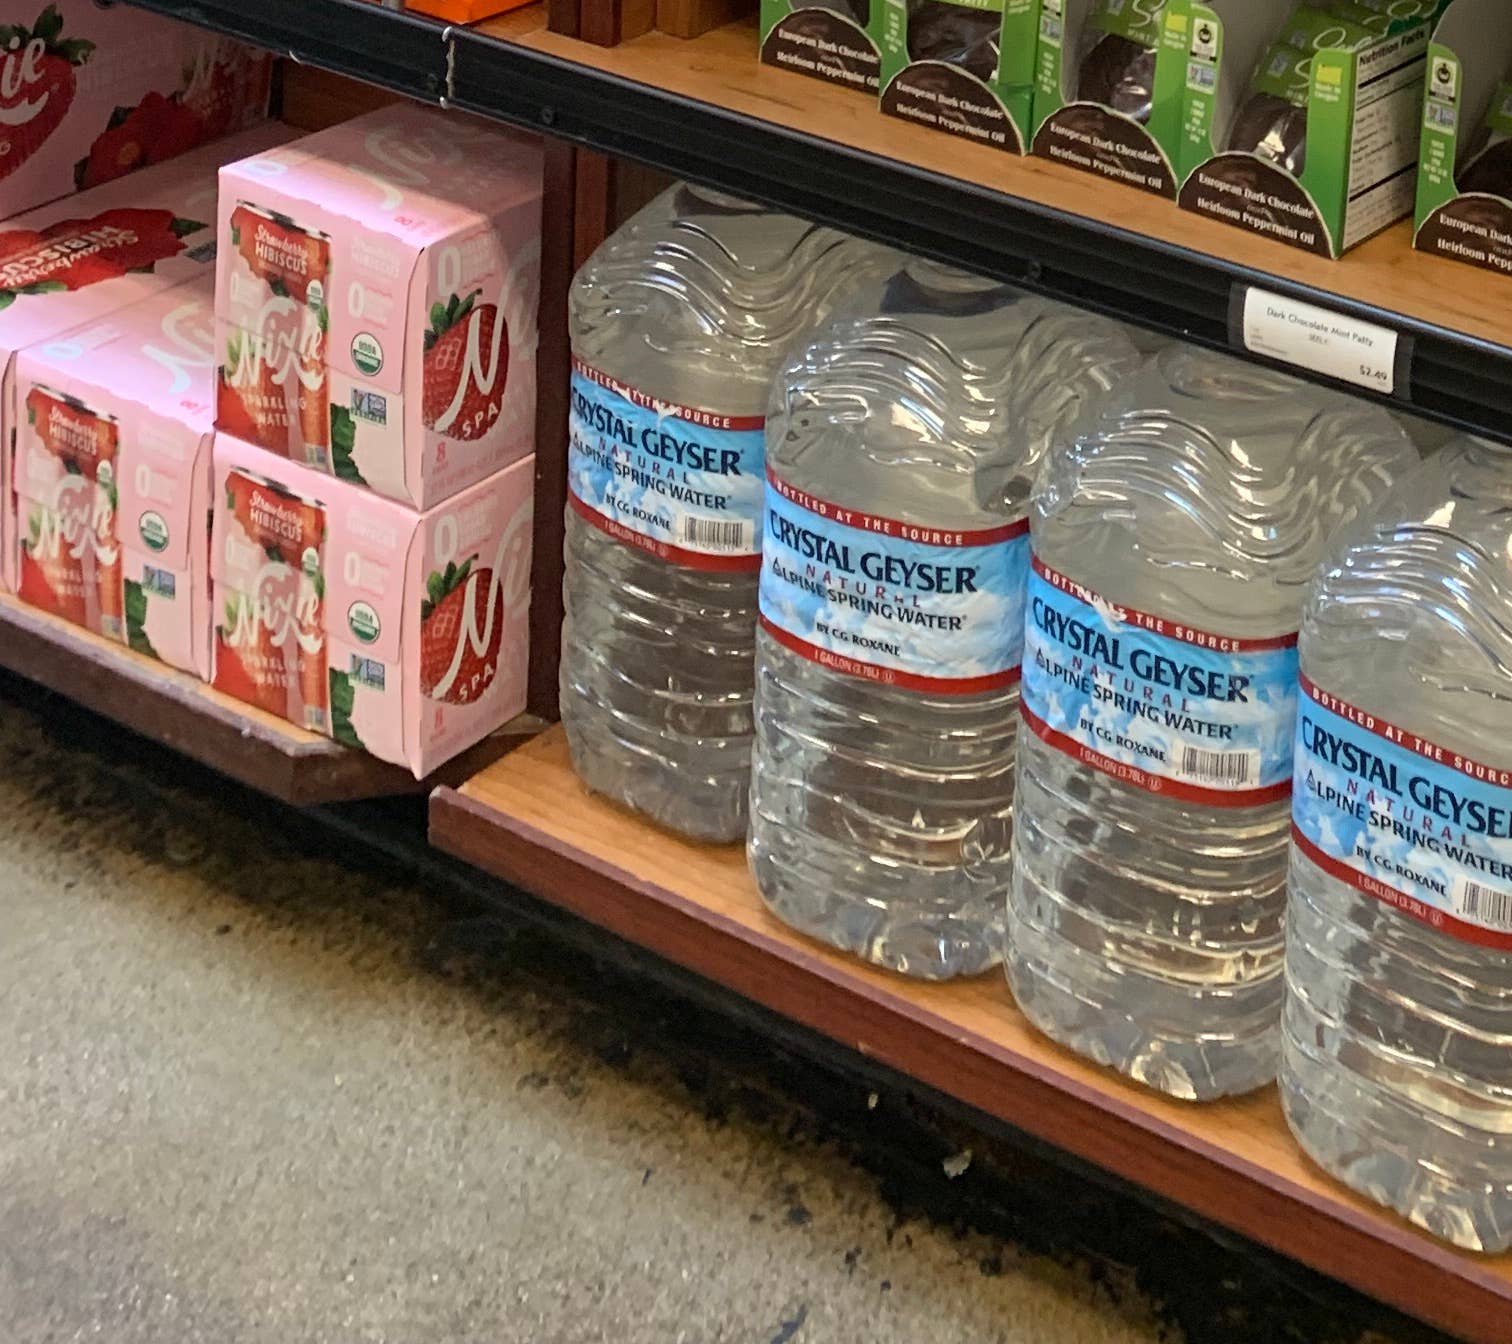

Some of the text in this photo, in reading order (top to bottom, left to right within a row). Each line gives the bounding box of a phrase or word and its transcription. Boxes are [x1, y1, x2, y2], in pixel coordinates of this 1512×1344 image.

[254, 224, 309, 259] Strawberry
[1437, 238, 1486, 263] Heirloom
[1439, 214, 1488, 237] European
[1490, 228, 1512, 245] Dark
[254, 242, 307, 276] HIBISCUS
[1359, 365, 1388, 381] $2.49
[641, 428, 742, 477] GEYSER
[614, 462, 728, 510] SPRING WATER
[769, 509, 978, 594] CRYSTAL GEYSER
[826, 586, 894, 621] SPRING
[895, 606, 963, 632] WATER
[1031, 595, 1250, 706] CRYSTAL GEYSER
[1302, 714, 1403, 798] CRYSTAL
